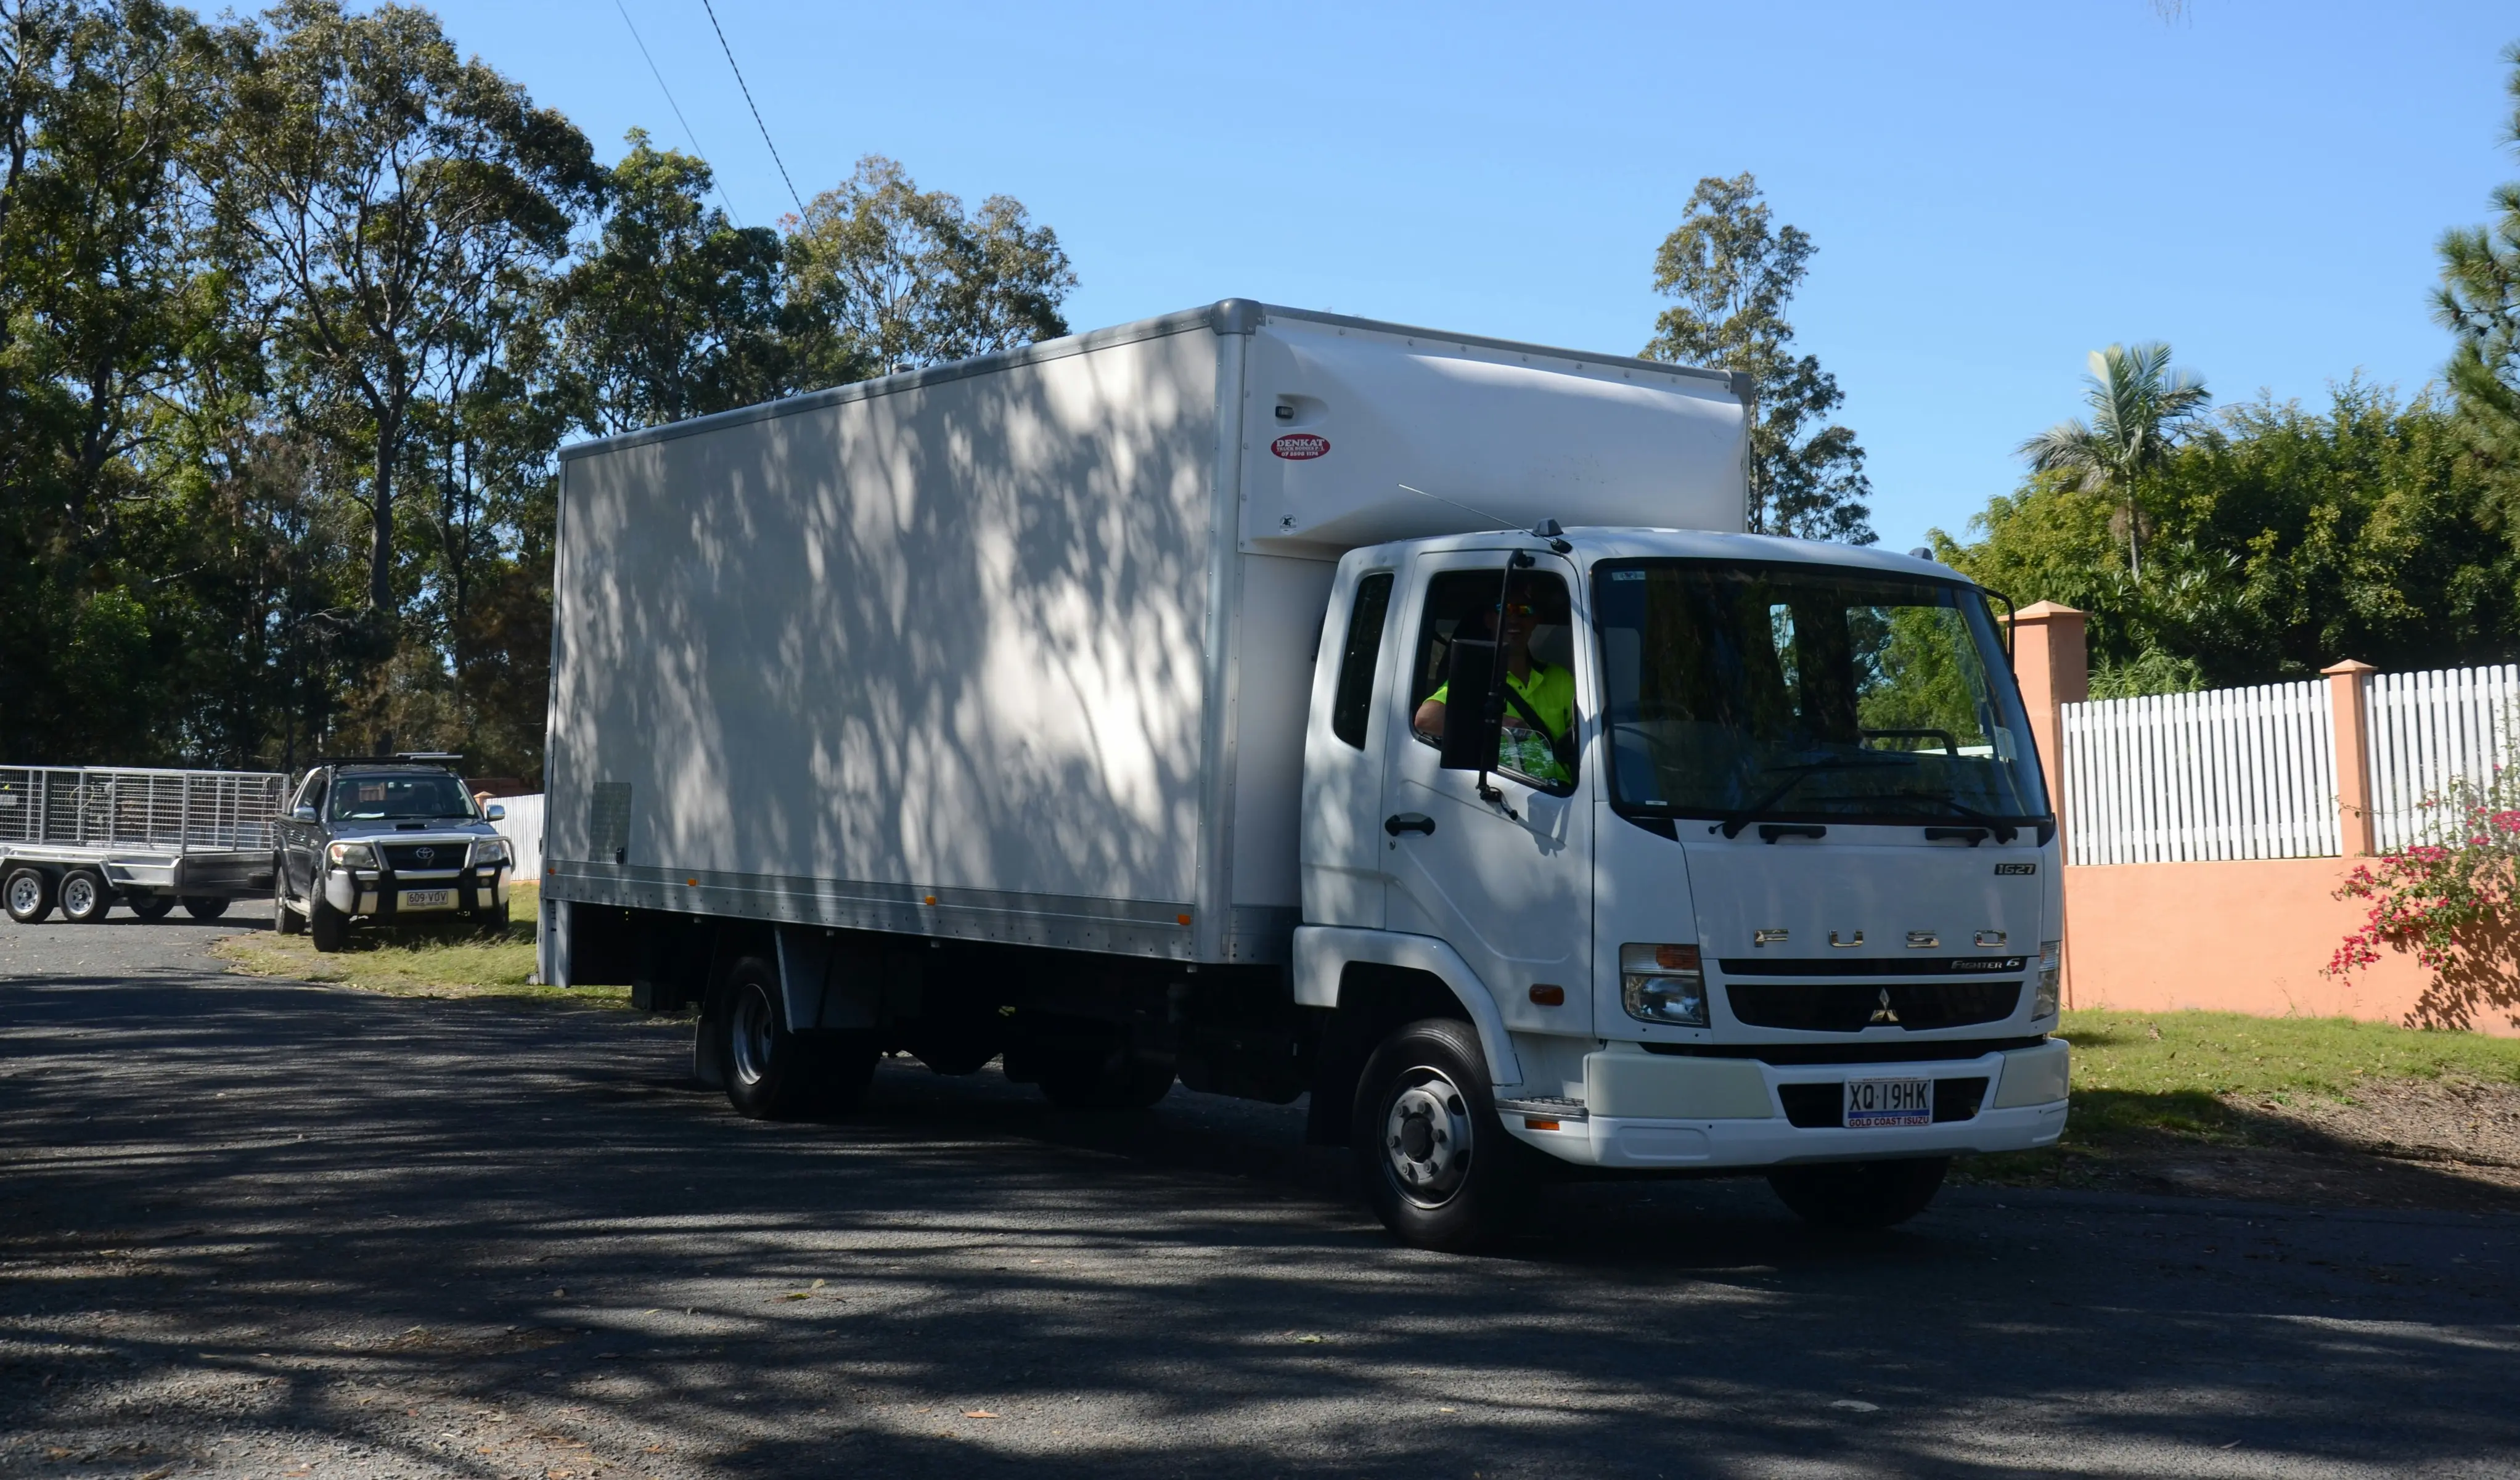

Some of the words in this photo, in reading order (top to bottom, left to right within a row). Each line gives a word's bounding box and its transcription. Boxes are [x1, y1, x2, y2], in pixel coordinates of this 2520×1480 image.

[1276, 439, 1325, 447] DENKAT
[1998, 864, 2034, 874] 1627
[409, 893, 425, 902] 609
[1754, 929, 2007, 949] FUSO
[2006, 958, 2020, 967] 6
[1849, 1118, 1872, 1127] GOLD
[1874, 1117, 1902, 1126] COAST
[1904, 1116, 1929, 1125] ISUZU
